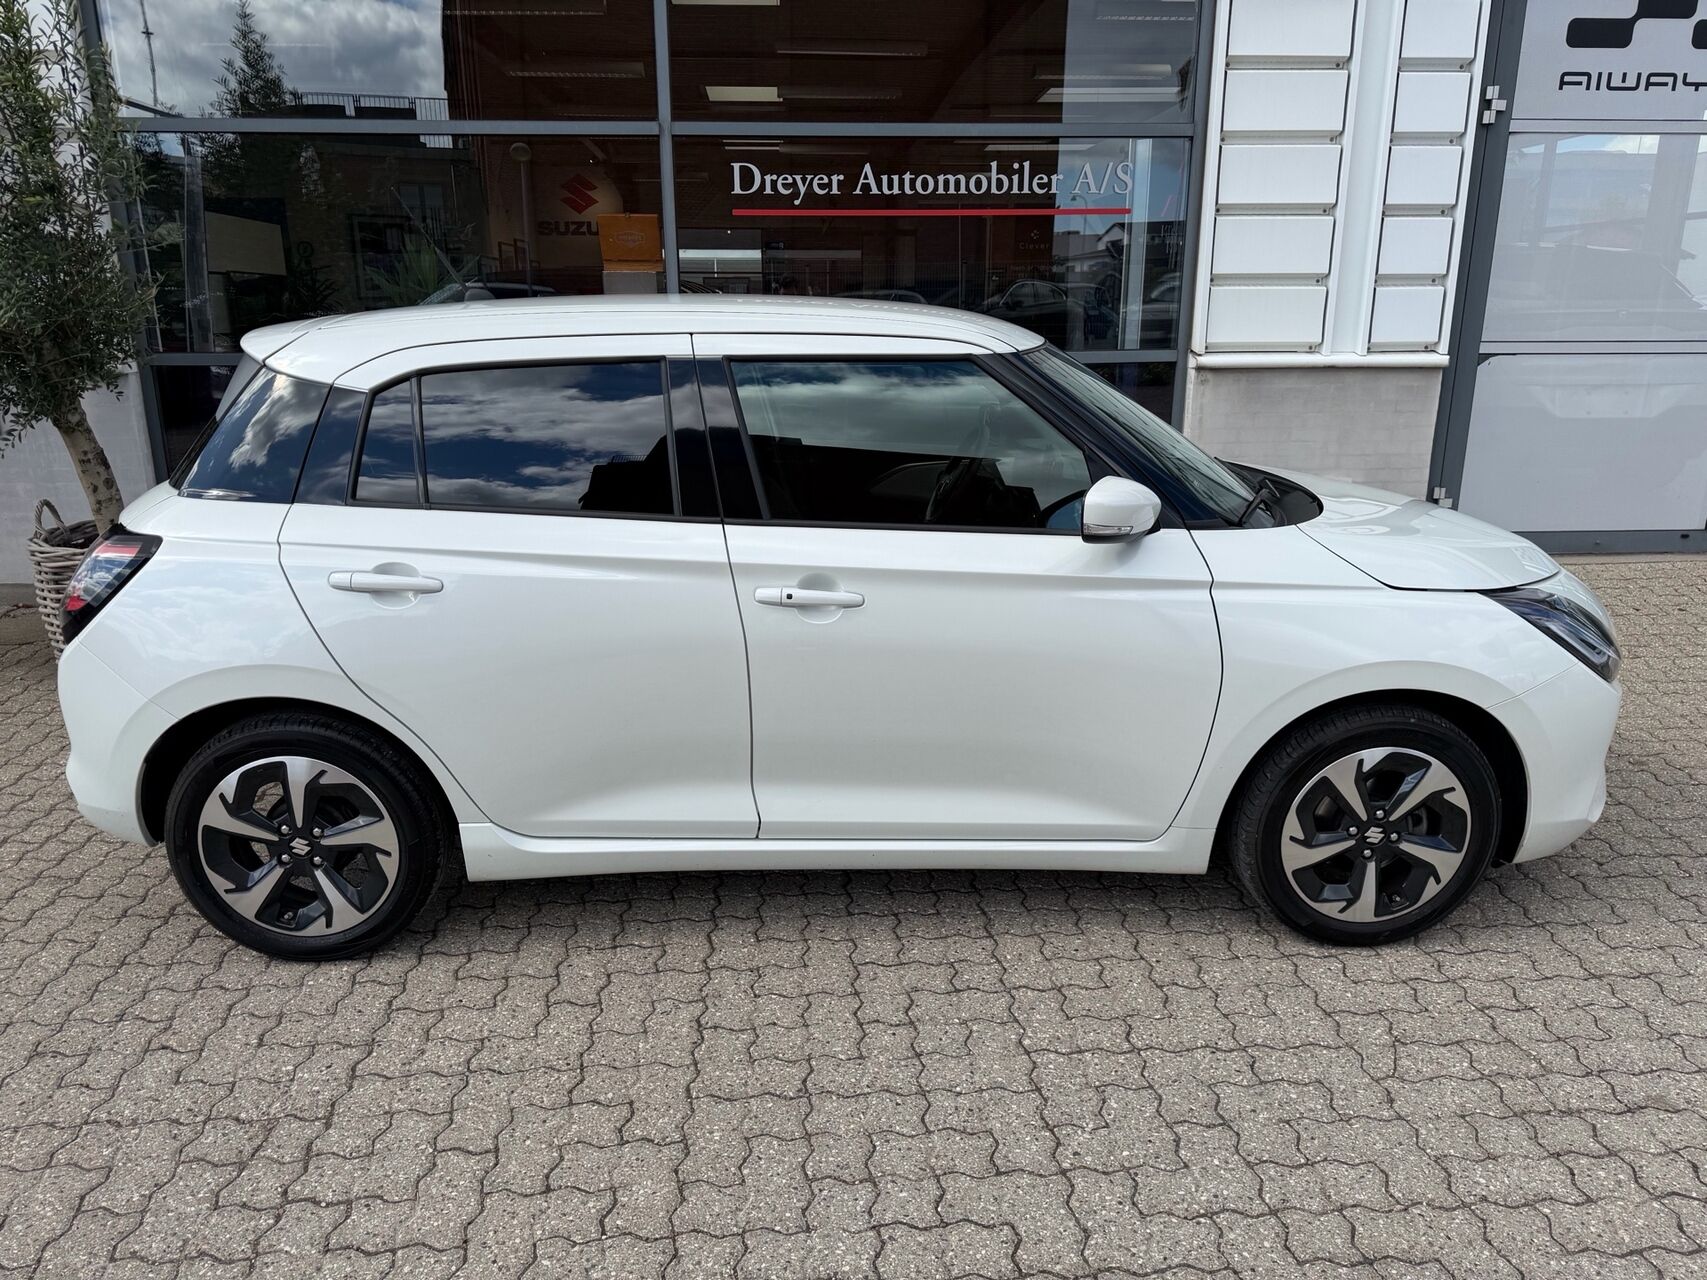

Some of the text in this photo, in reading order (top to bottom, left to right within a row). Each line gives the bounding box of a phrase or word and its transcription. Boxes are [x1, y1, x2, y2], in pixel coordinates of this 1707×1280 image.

[730, 160, 1134, 206] Dreyer Automobiler A/S
